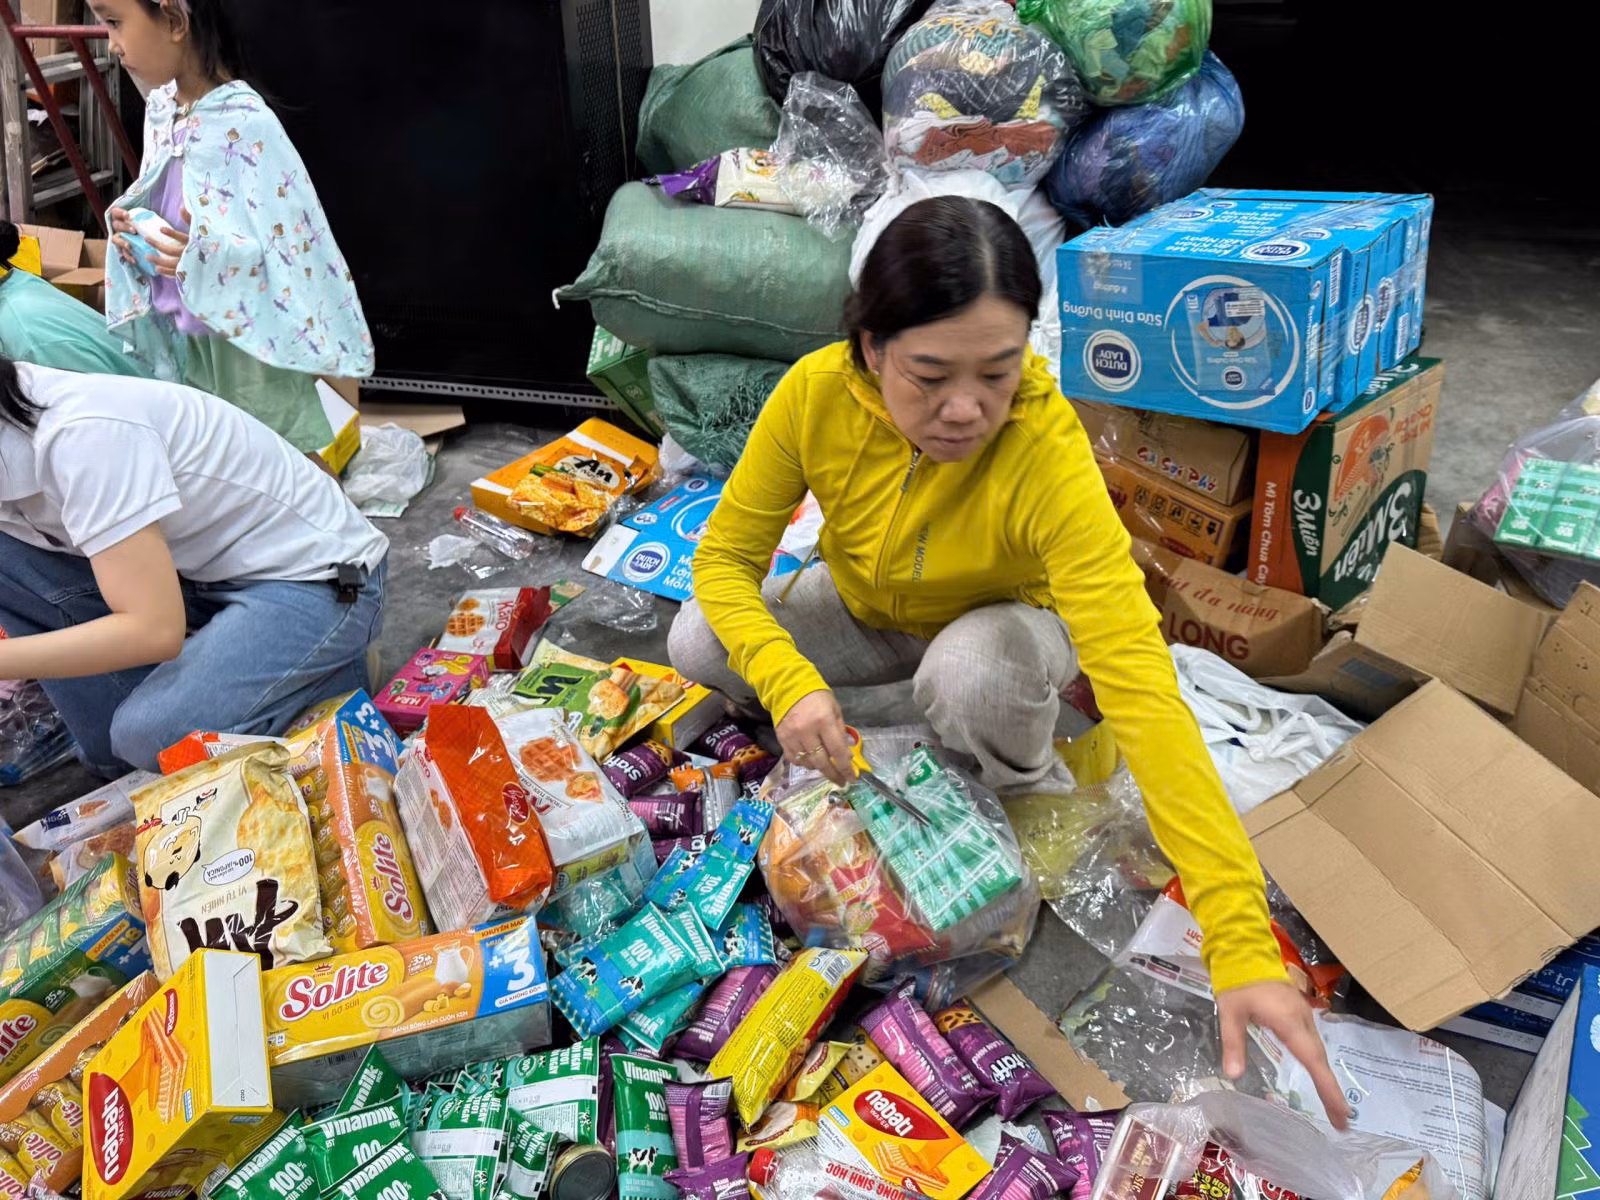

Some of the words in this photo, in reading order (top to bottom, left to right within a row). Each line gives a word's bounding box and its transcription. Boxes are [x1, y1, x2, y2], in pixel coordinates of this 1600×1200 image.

[1062, 301, 1102, 320] Dưỡng
[1105, 309, 1134, 324] Dinh
[1136, 312, 1163, 328] Sữa
[1095, 358, 1128, 372] DUTCH
[1098, 349, 1124, 361] LADY
[635, 552, 662, 566] DUTCH
[1259, 530, 1272, 562] Chua
[636, 560, 657, 571] LADY
[911, 543, 926, 583] MODEL
[663, 574, 685, 590] Mỗi
[1169, 612, 1249, 660] LONG
[603, 753, 641, 782] Staff
[372, 832, 414, 922] Solite
[708, 861, 751, 916] Vinamilk
[640, 912, 687, 962] Vinamilk
[678, 910, 712, 963] Vinamilk
[279, 960, 390, 1022] Solite
[320, 1106, 400, 1138] Vinamilk
[865, 1090, 915, 1137] nabati
[869, 1109, 890, 1130] WAFER
[24, 1132, 63, 1176] olite
[225, 1124, 301, 1190] Vinamilk
[339, 1142, 410, 1197] Vinamilk
[268, 1160, 308, 1193] 100%
[824, 1161, 849, 1182] HỌC
[849, 1171, 876, 1192] SINH
